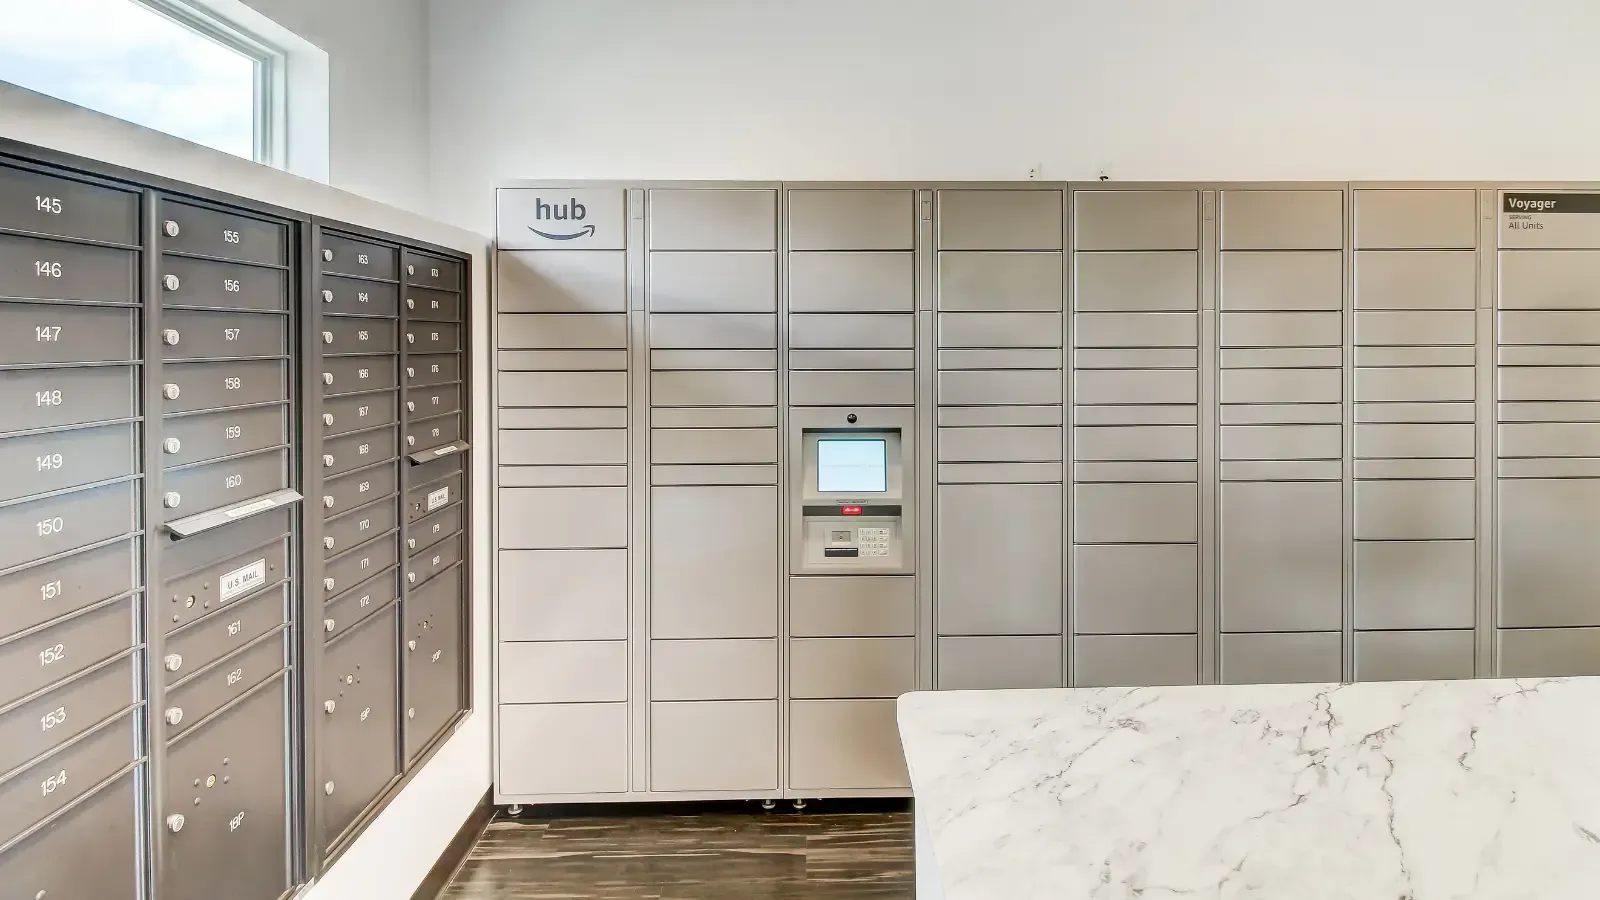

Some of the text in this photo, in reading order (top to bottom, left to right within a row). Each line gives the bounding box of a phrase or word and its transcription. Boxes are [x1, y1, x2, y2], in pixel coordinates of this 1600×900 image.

[36, 196, 62, 214] 145
[536, 197, 586, 220] hub
[1508, 197, 1557, 211] Voyager
[1508, 221, 1544, 230] All Units
[224, 230, 240, 244] 155
[358, 254, 369, 265] 163
[35, 261, 62, 278] 146
[224, 280, 240, 293] 156
[358, 292, 369, 303] 164
[36, 326, 62, 342] 147
[225, 329, 240, 341] 157
[358, 330, 369, 341] 165
[358, 368, 369, 379] 166
[225, 377, 241, 390] 158
[36, 390, 63, 407] 148
[358, 405, 369, 417] 167
[226, 426, 241, 440] 159
[358, 443, 369, 455] 168
[36, 454, 63, 472] 149
[226, 475, 242, 489] 160
[359, 481, 370, 493] 169
[37, 517, 64, 537] 150
[359, 518, 370, 531] 170
[360, 557, 369, 570] 171
[227, 578, 241, 590] U.S.
[242, 570, 258, 583] MAIL
[41, 580, 61, 601] 151
[359, 594, 370, 608] 172
[228, 620, 241, 637] 161
[39, 644, 65, 667] 152
[227, 669, 243, 686] 162
[41, 707, 66, 732] 153
[41, 770, 68, 797] 154
[229, 812, 245, 833] 18P
